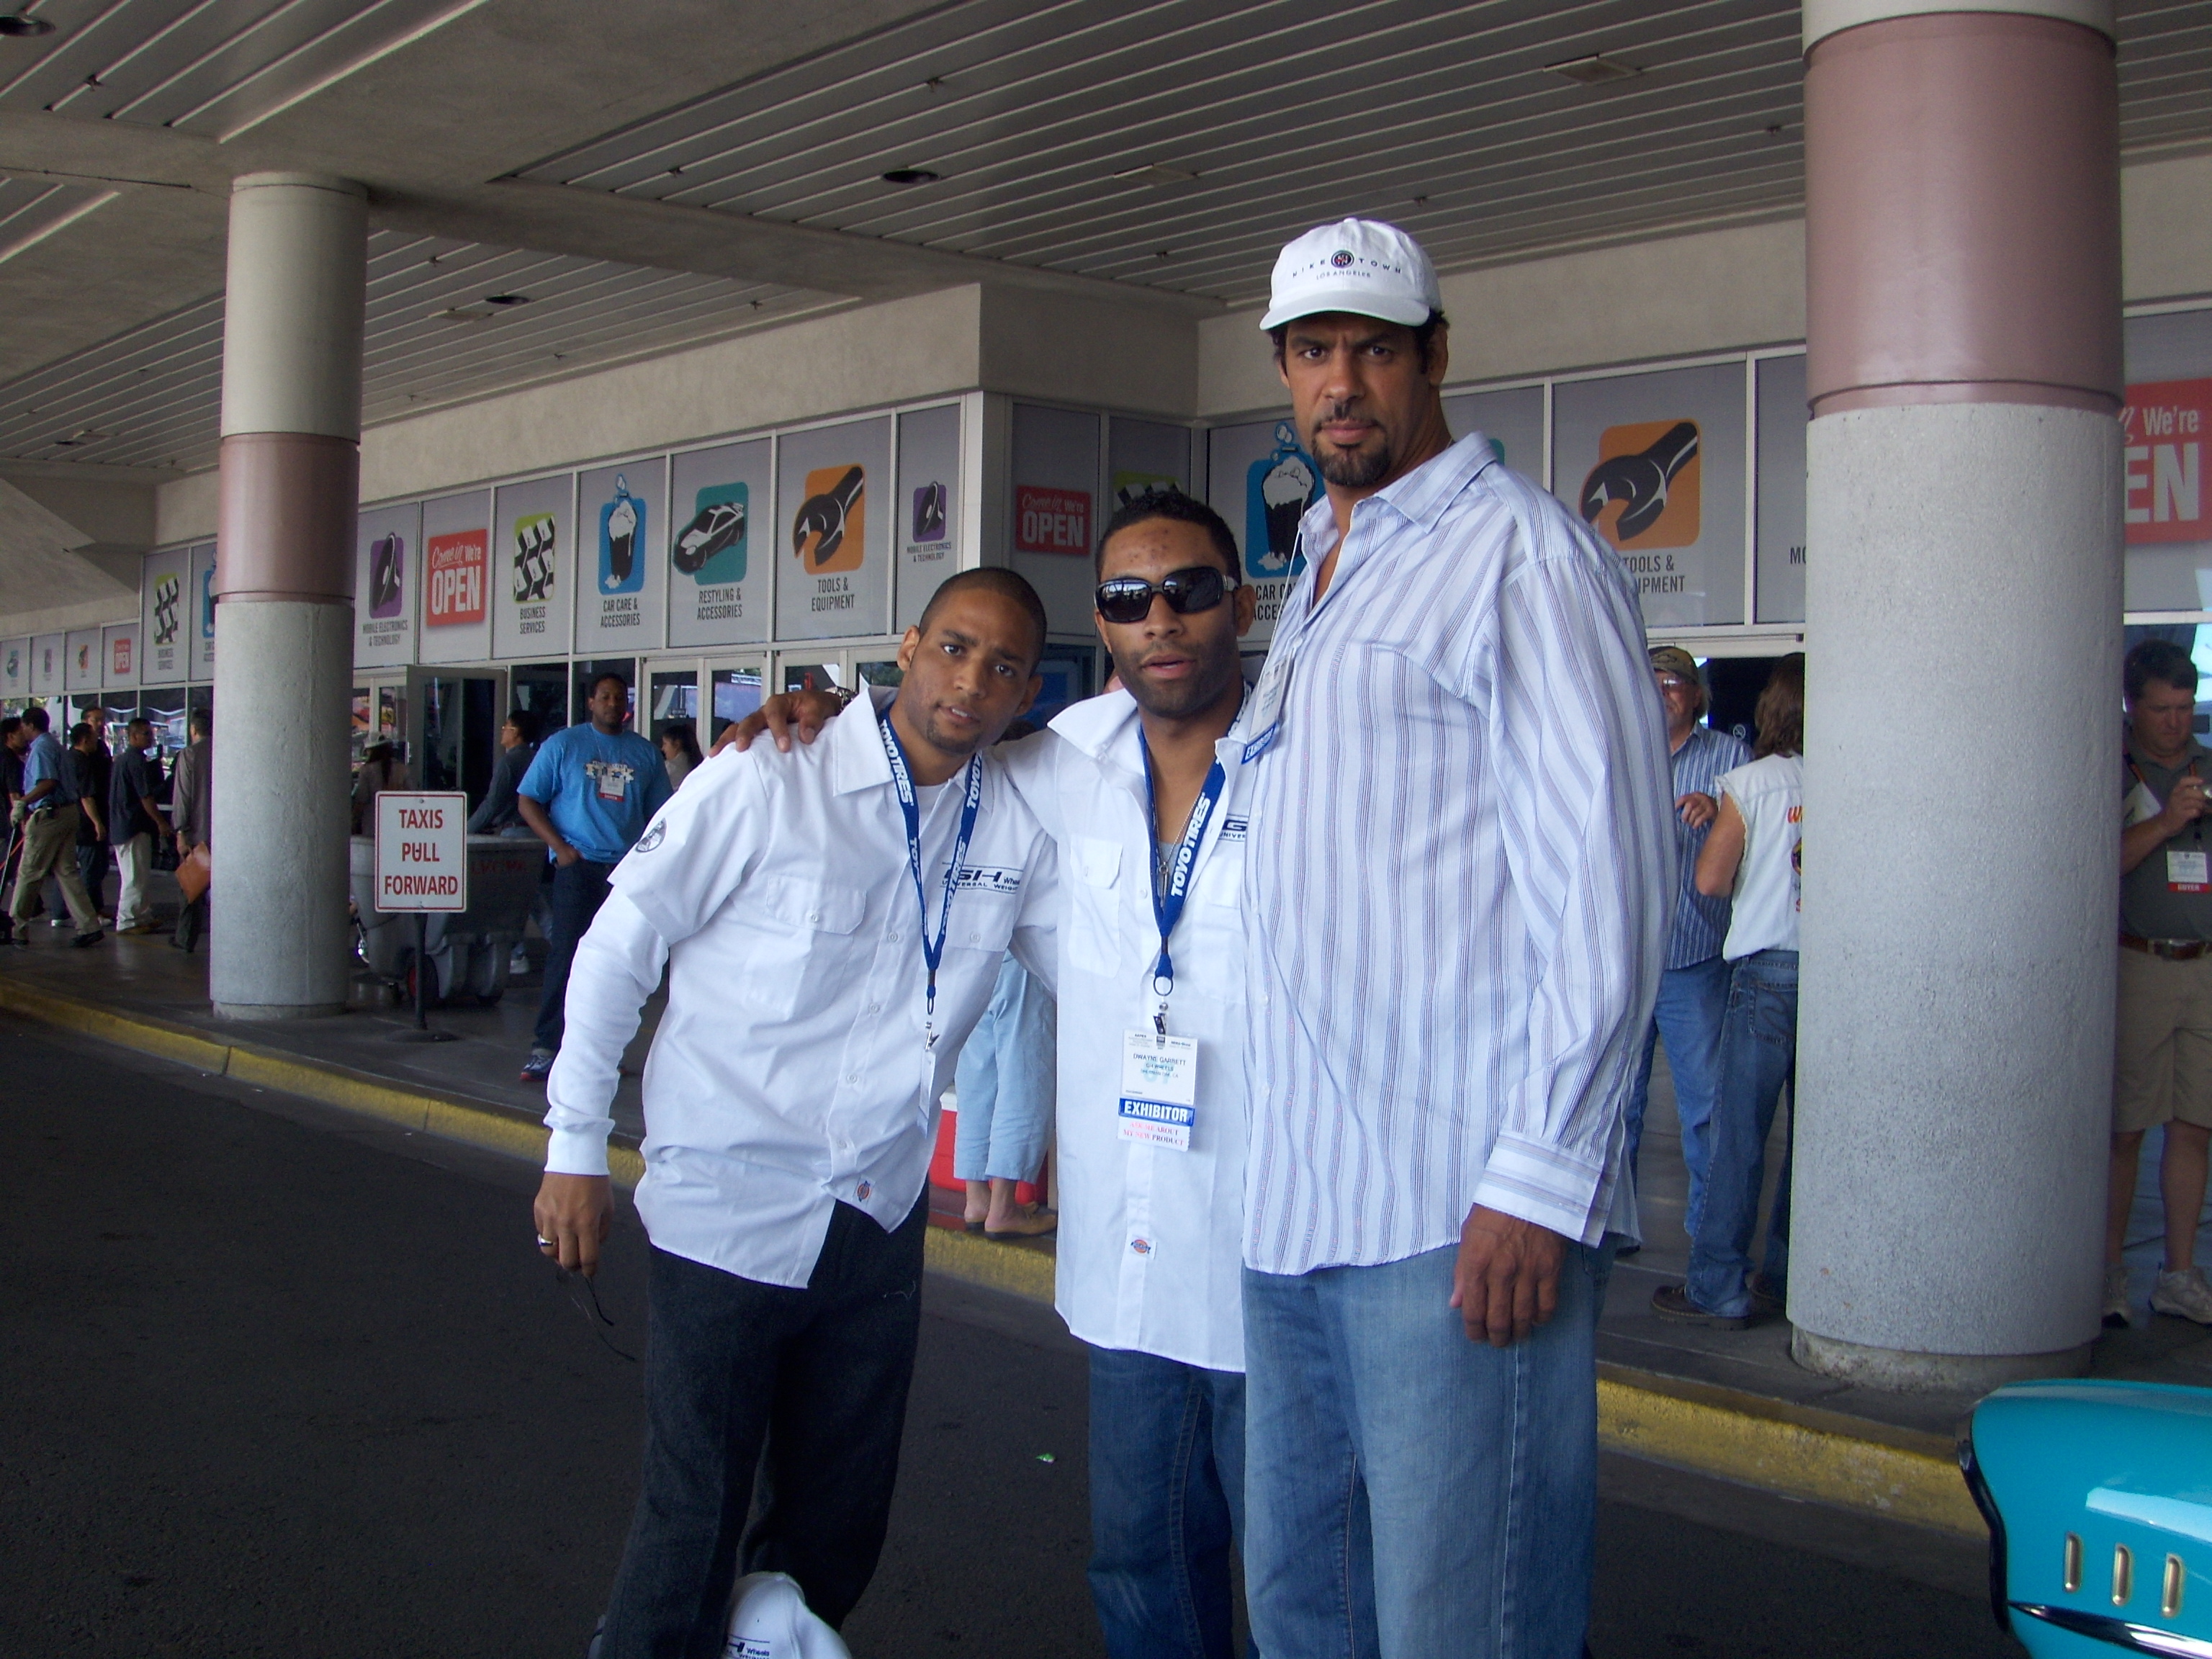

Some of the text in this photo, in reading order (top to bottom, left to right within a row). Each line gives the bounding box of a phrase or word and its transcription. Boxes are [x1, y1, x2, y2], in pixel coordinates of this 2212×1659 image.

[2142, 405, 2199, 436] We're
[2124, 441, 2199, 523] EN
[1022, 510, 1084, 547] OPEN
[1622, 554, 1674, 573] TOOLS &
[432, 565, 481, 615] OPEN
[817, 577, 849, 593] TOOLS &
[1256, 583, 1296, 601] CAR CA
[1637, 575, 1685, 594] IPMENT
[698, 587, 742, 604] RESTYLING &
[811, 594, 855, 612] EQUIPMENT
[519, 606, 546, 620] BUSINESS
[603, 597, 638, 613] CAR CARE &
[696, 605, 742, 621] ACCESSORIES
[519, 621, 545, 634] SERVICES
[600, 613, 640, 628] ACCESSORIES
[399, 809, 444, 829] TAXIS
[402, 842, 440, 862] PULL
[384, 876, 458, 896] FORWARD
[1124, 1100, 1188, 1123] EXHIBITOR
[1152, 1134, 1184, 1146] PRODUCT
[1157, 1126, 1179, 1136] ABOUT
